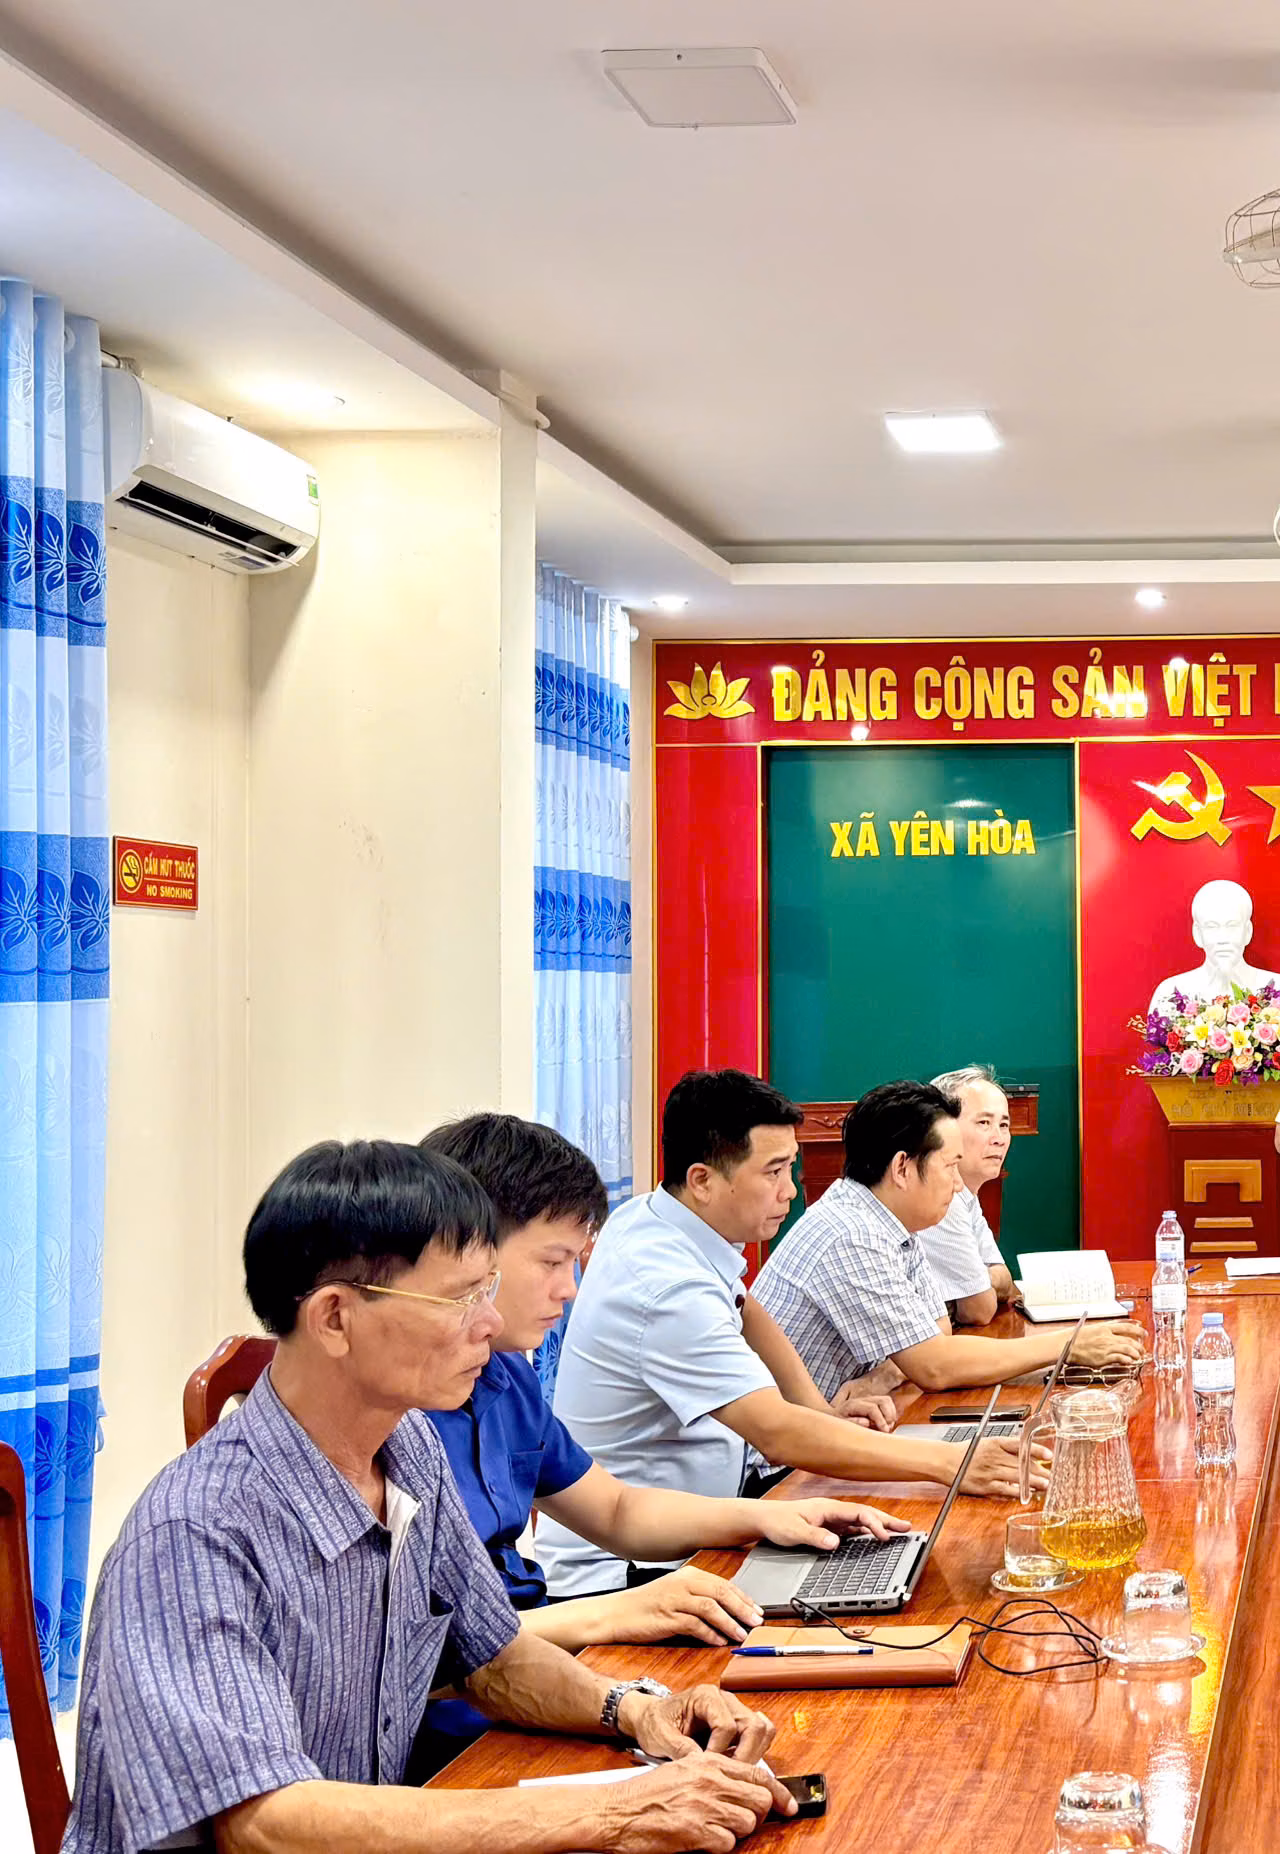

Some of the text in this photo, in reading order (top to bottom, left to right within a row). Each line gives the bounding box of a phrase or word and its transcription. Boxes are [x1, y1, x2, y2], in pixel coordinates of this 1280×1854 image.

[772, 649, 897, 721] ĐẢNG
[914, 655, 1034, 731] CỘNG
[1051, 647, 1148, 718] SẢN
[1162, 652, 1257, 727] VIỆT
[830, 809, 1036, 858] XÃ YÊN HÒA
[147, 884, 193, 900] NO SMOKING
